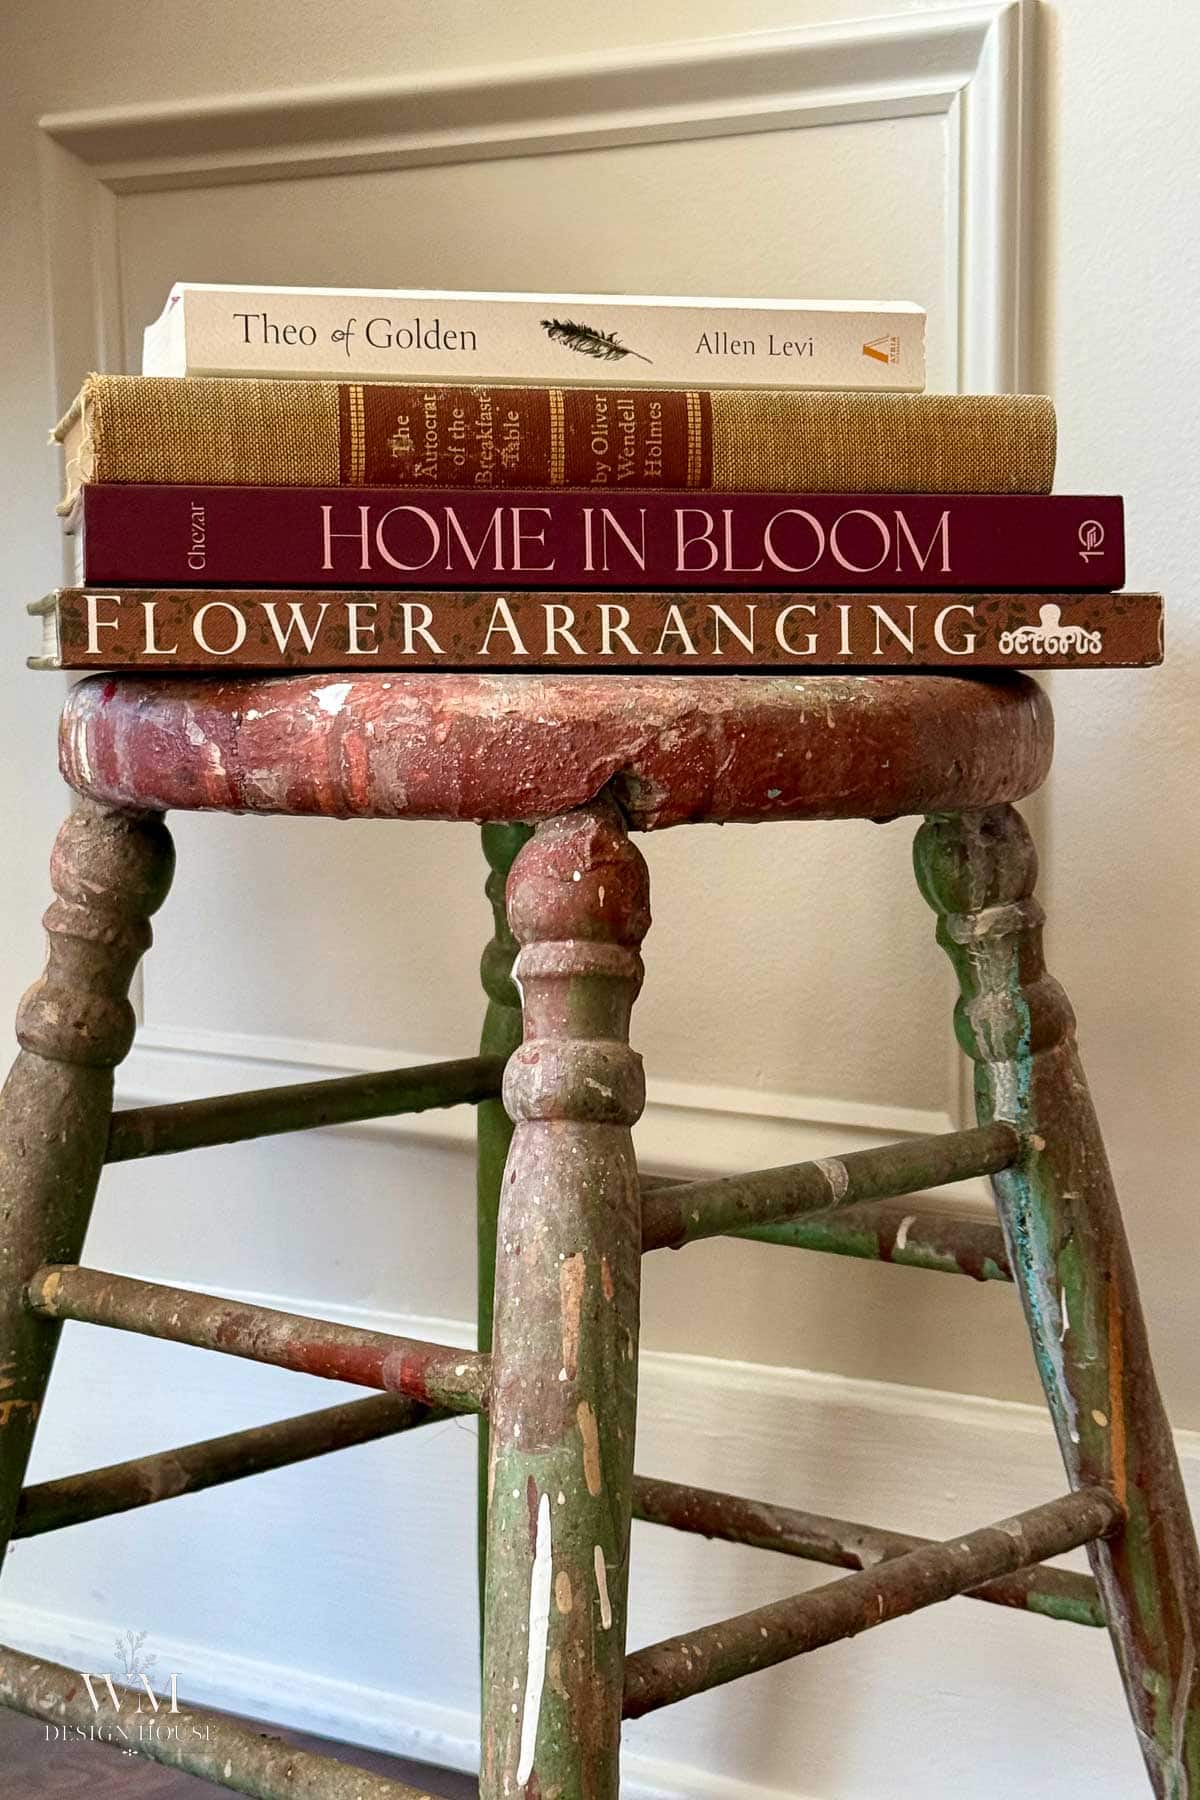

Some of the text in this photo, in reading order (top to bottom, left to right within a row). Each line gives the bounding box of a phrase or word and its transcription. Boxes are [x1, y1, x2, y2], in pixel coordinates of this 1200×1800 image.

[233, 313, 478, 357] Theo of Golden
[696, 332, 814, 358] Allen Levi
[392, 415, 413, 458] The
[421, 392, 438, 481] Autocrat
[448, 407, 466, 466] of the
[501, 410, 521, 467] Table
[591, 394, 611, 483] by Oliver
[617, 399, 636, 481] Wendell
[644, 402, 663, 477] Holmes
[187, 501, 206, 570] Chezar
[320, 505, 953, 573] HOME IN BLOOM
[82, 595, 977, 657] FLOWER ARRANGING
